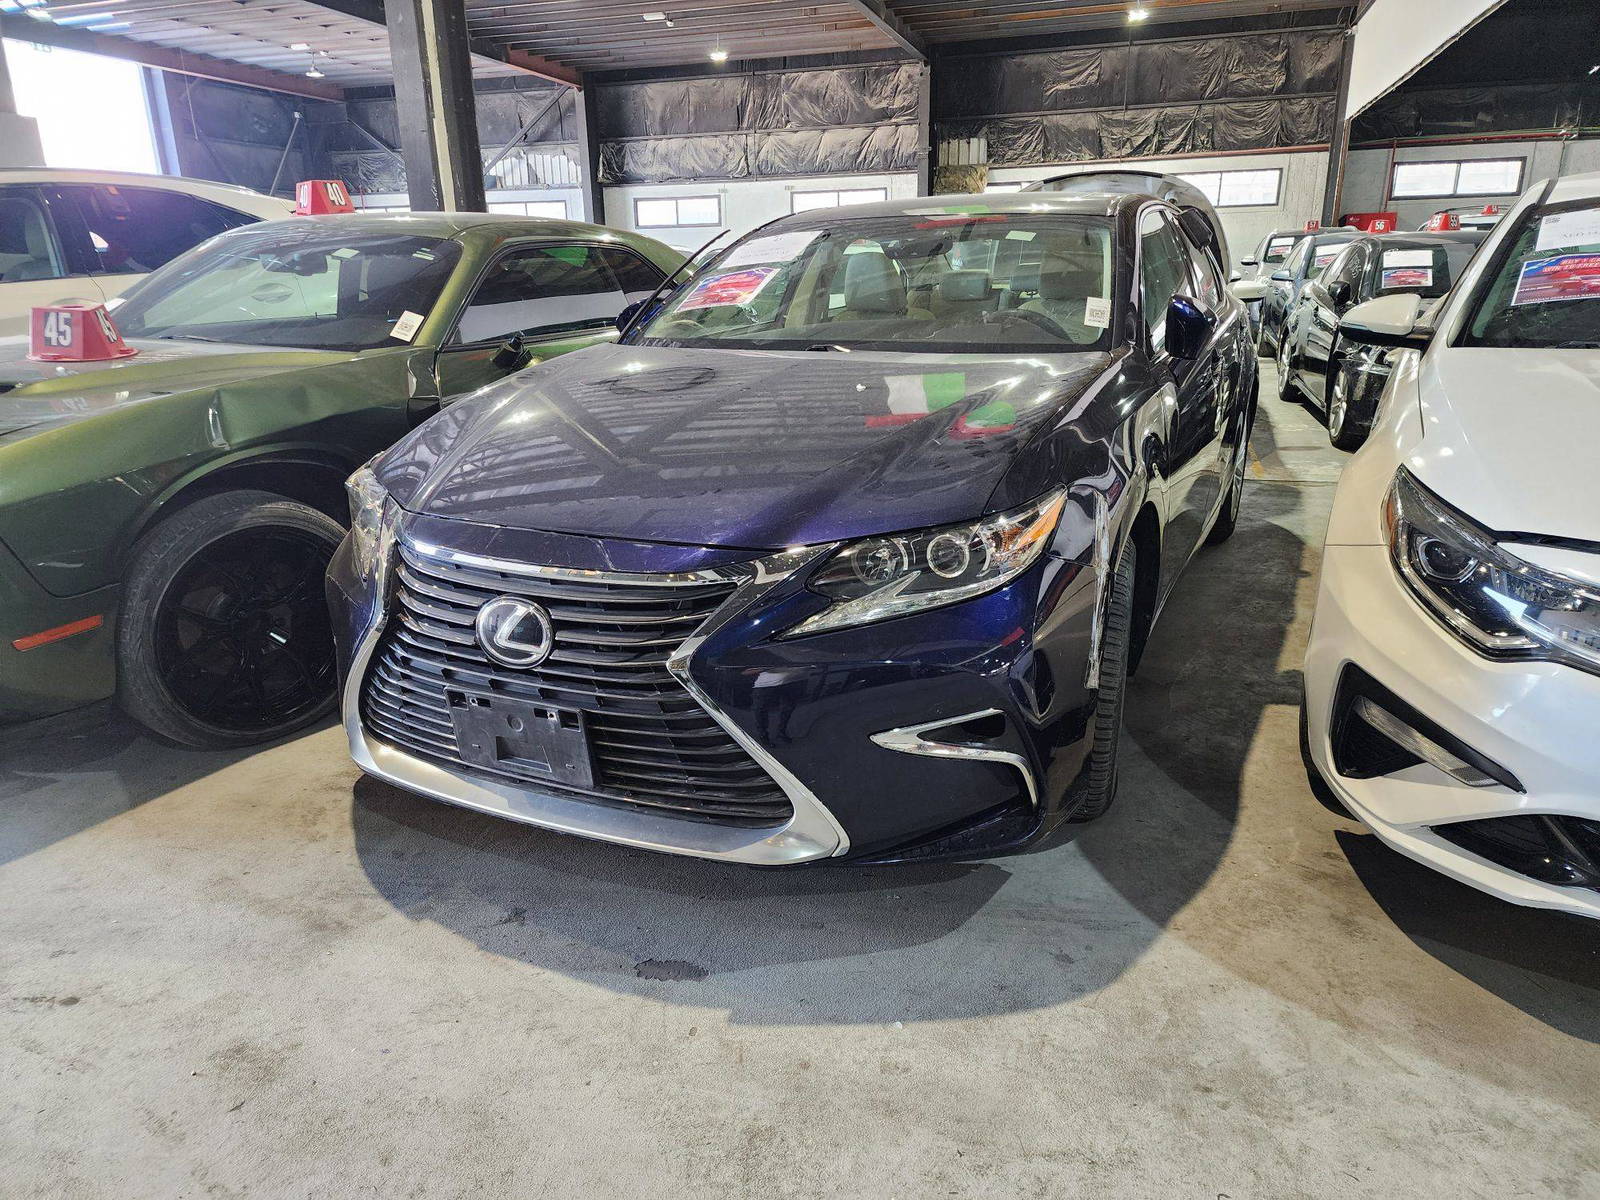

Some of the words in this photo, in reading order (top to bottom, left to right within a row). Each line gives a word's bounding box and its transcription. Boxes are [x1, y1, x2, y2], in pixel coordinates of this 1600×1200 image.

[299, 184, 309, 208] 40
[326, 182, 346, 206] 40
[1375, 220, 1385, 230] 56
[1450, 214, 1459, 227] 55
[44, 311, 72, 346] 45
[95, 308, 118, 342] 45
